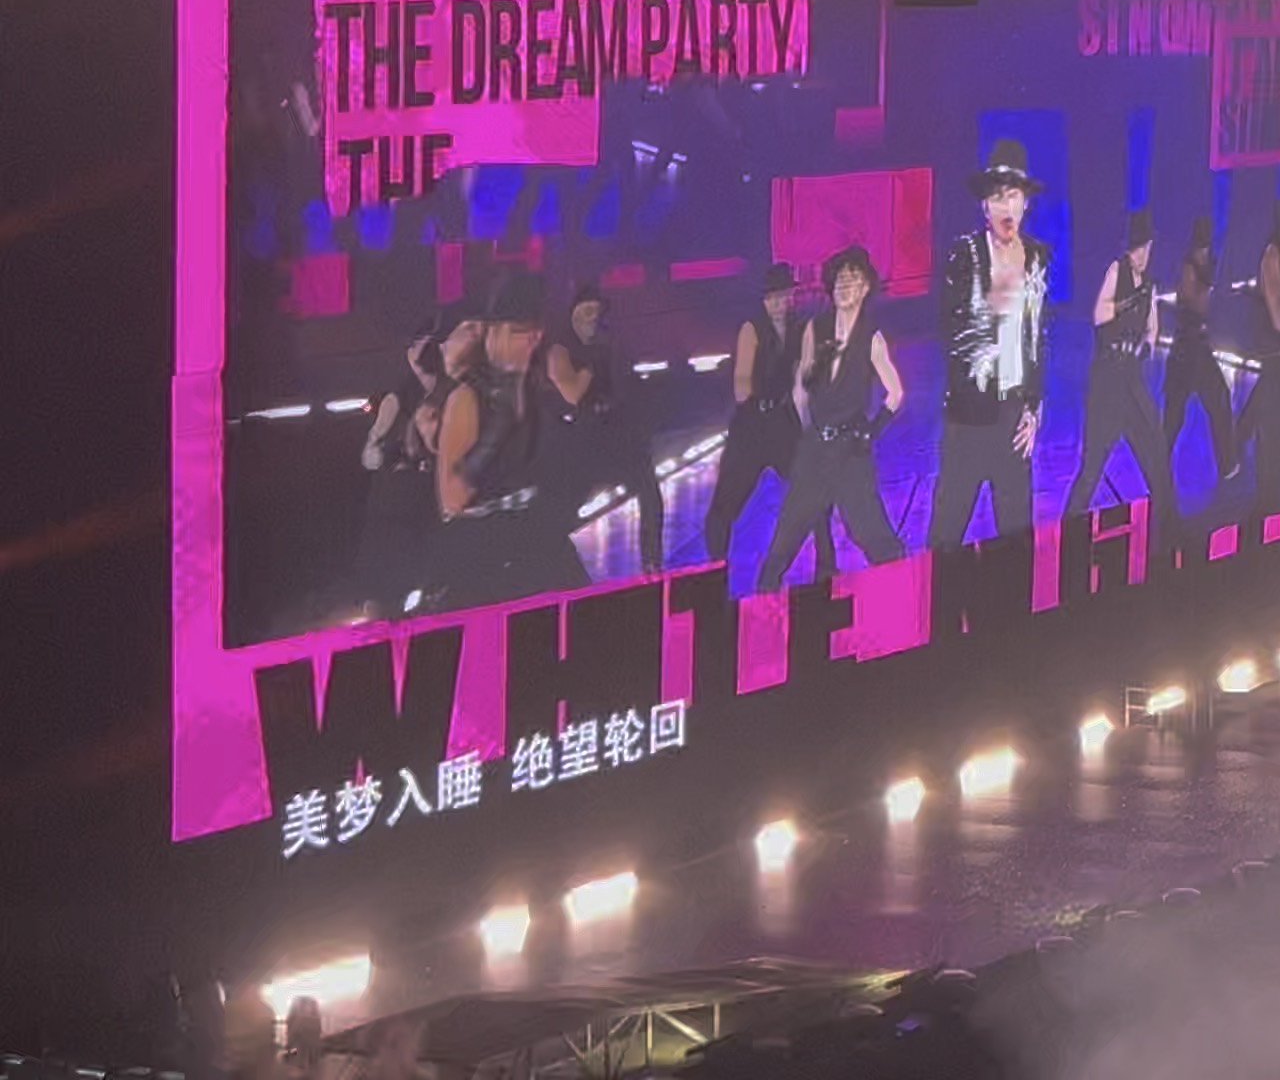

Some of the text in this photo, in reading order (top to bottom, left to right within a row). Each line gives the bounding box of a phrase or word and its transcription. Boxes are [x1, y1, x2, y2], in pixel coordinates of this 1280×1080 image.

[281, 699, 687, 860] 美梦入睡 绝望轮回
